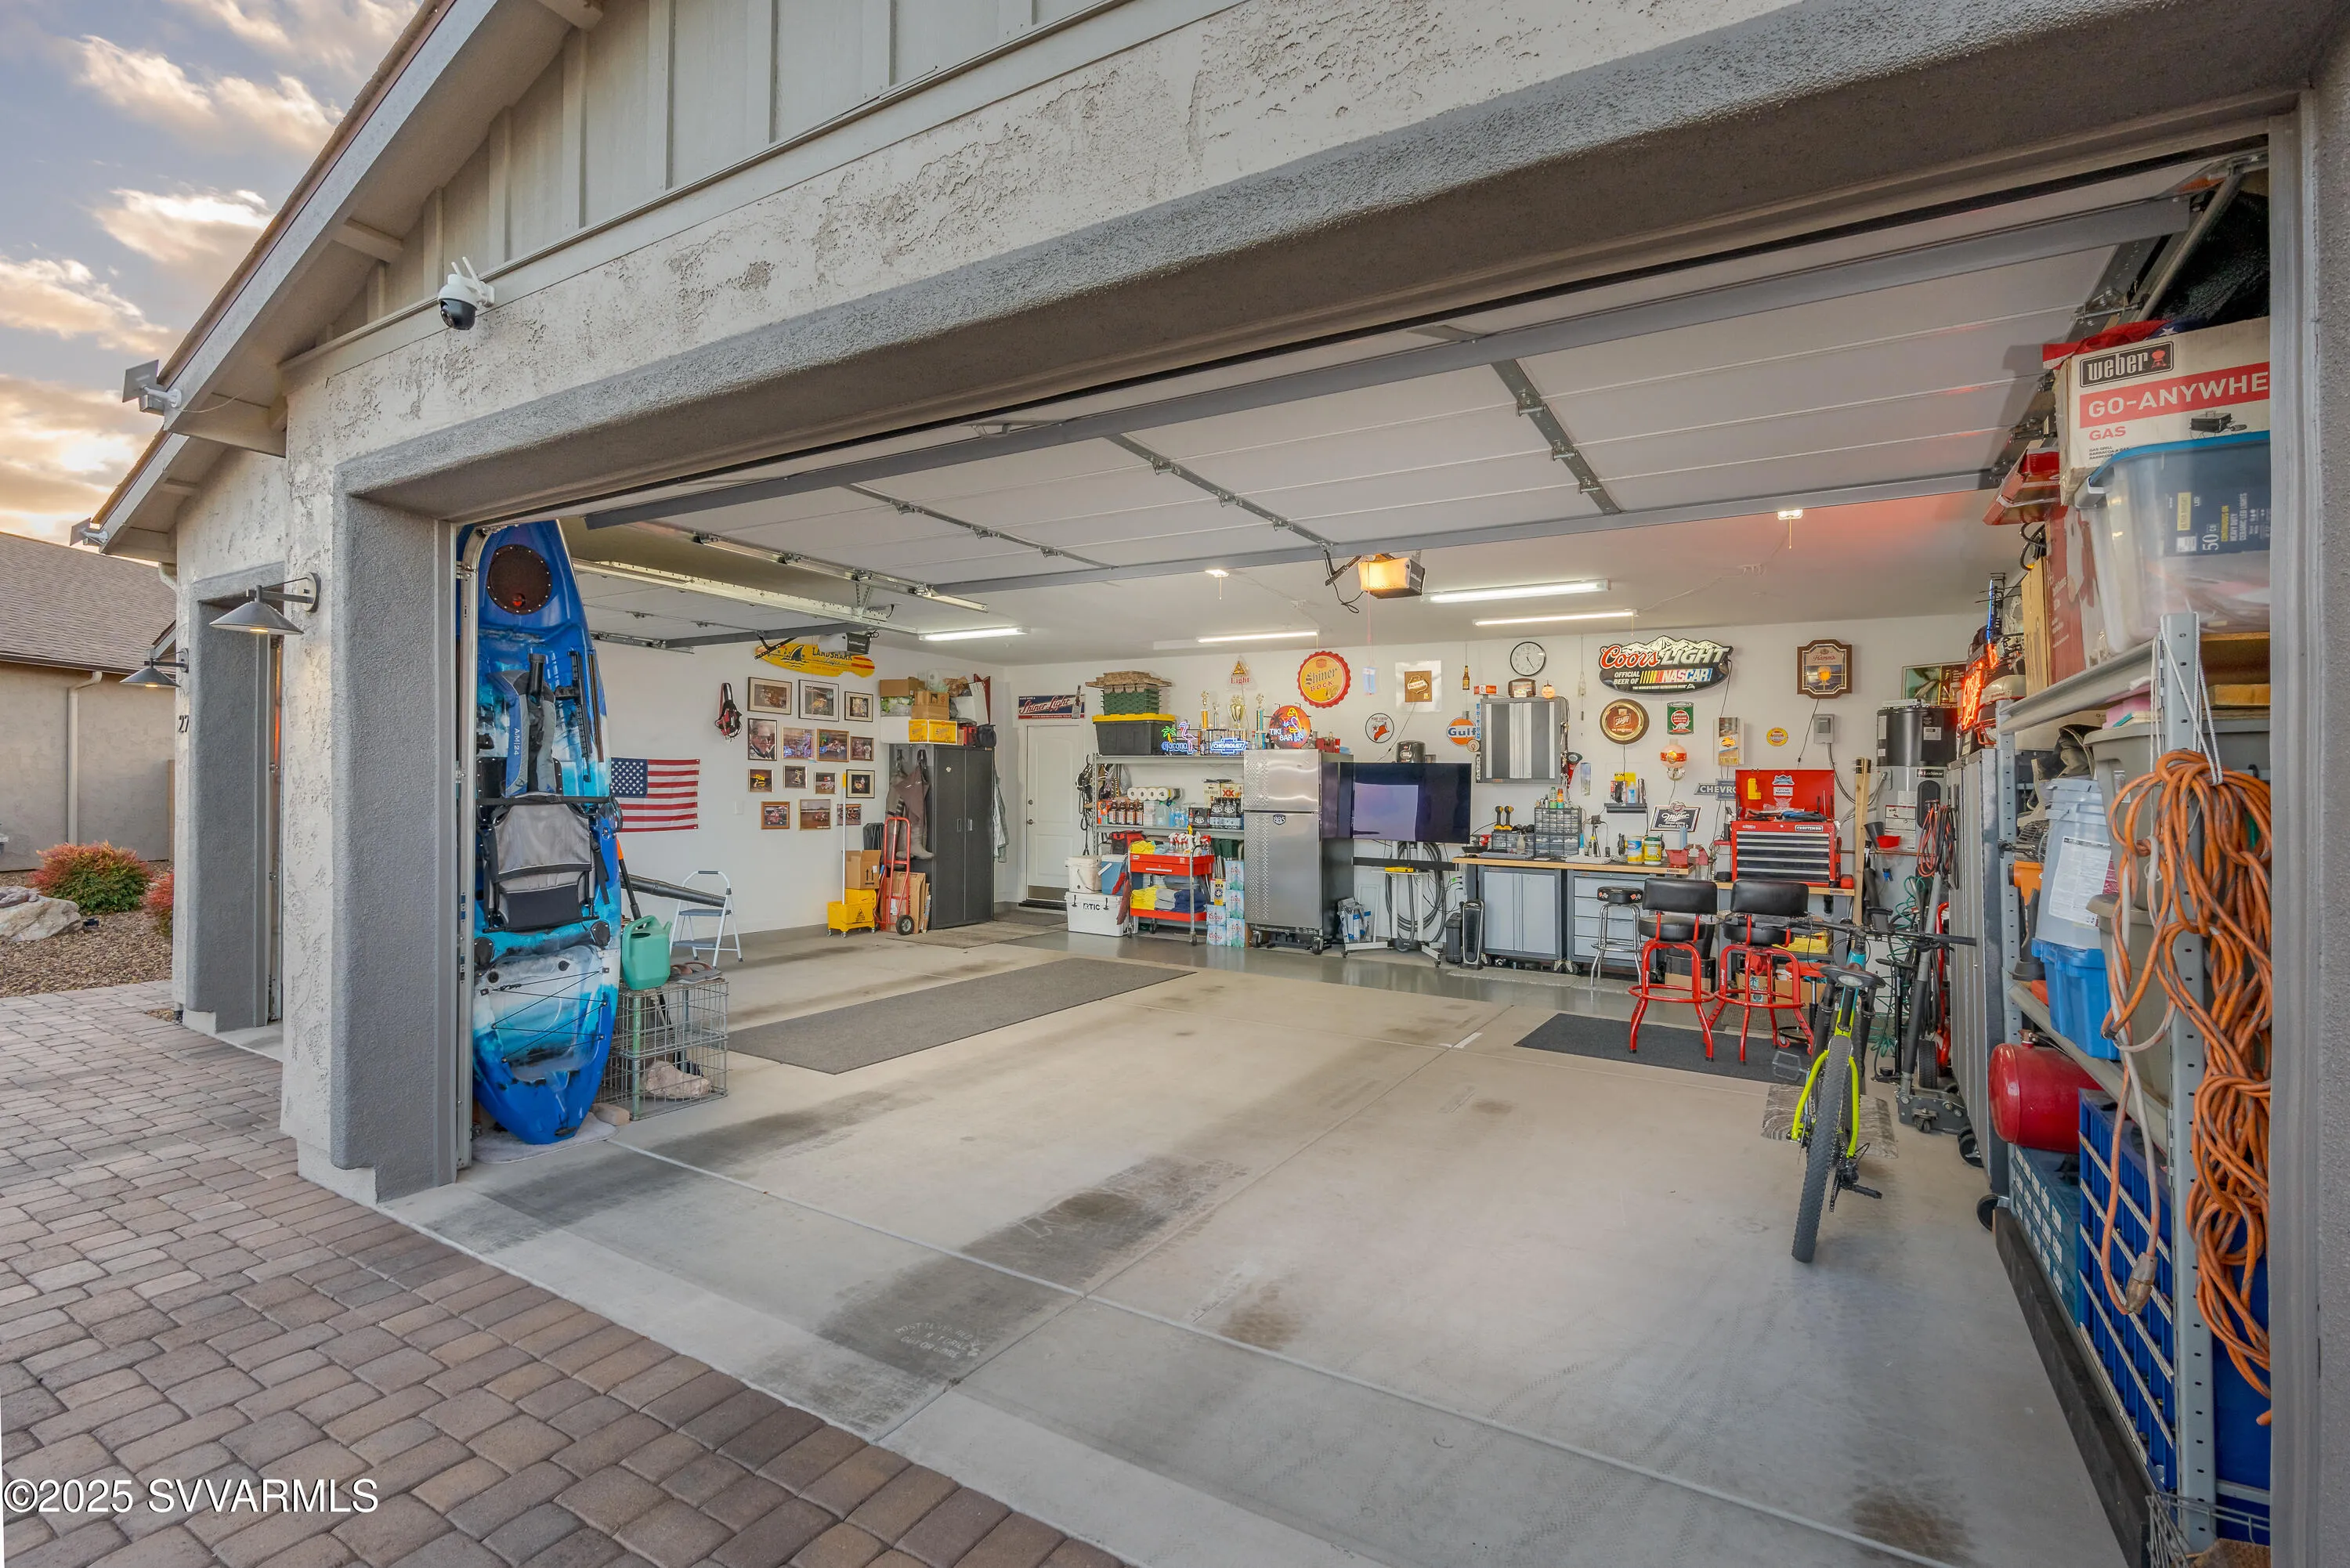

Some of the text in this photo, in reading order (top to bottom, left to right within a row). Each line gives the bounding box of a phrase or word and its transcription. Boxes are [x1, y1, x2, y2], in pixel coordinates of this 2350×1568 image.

[2088, 352, 2149, 381] weber
[2088, 372, 2269, 418] GO-ANYWHE
[2089, 426, 2126, 441] GAS
[2202, 533, 2220, 551] 50
[1600, 645, 1730, 669] Coors LIGHT
[1231, 676, 1249, 685] Light
[1306, 668, 1336, 685] Shiner
[1661, 668, 1713, 683] NASCAR
[1310, 681, 1333, 692] BOCK
[1018, 695, 1071, 714] Shiner Light
[178, 714, 189, 733] 27
[1448, 728, 1477, 736] Gulf
[1162, 741, 1188, 751] Corona
[1661, 811, 1690, 822] Miller
